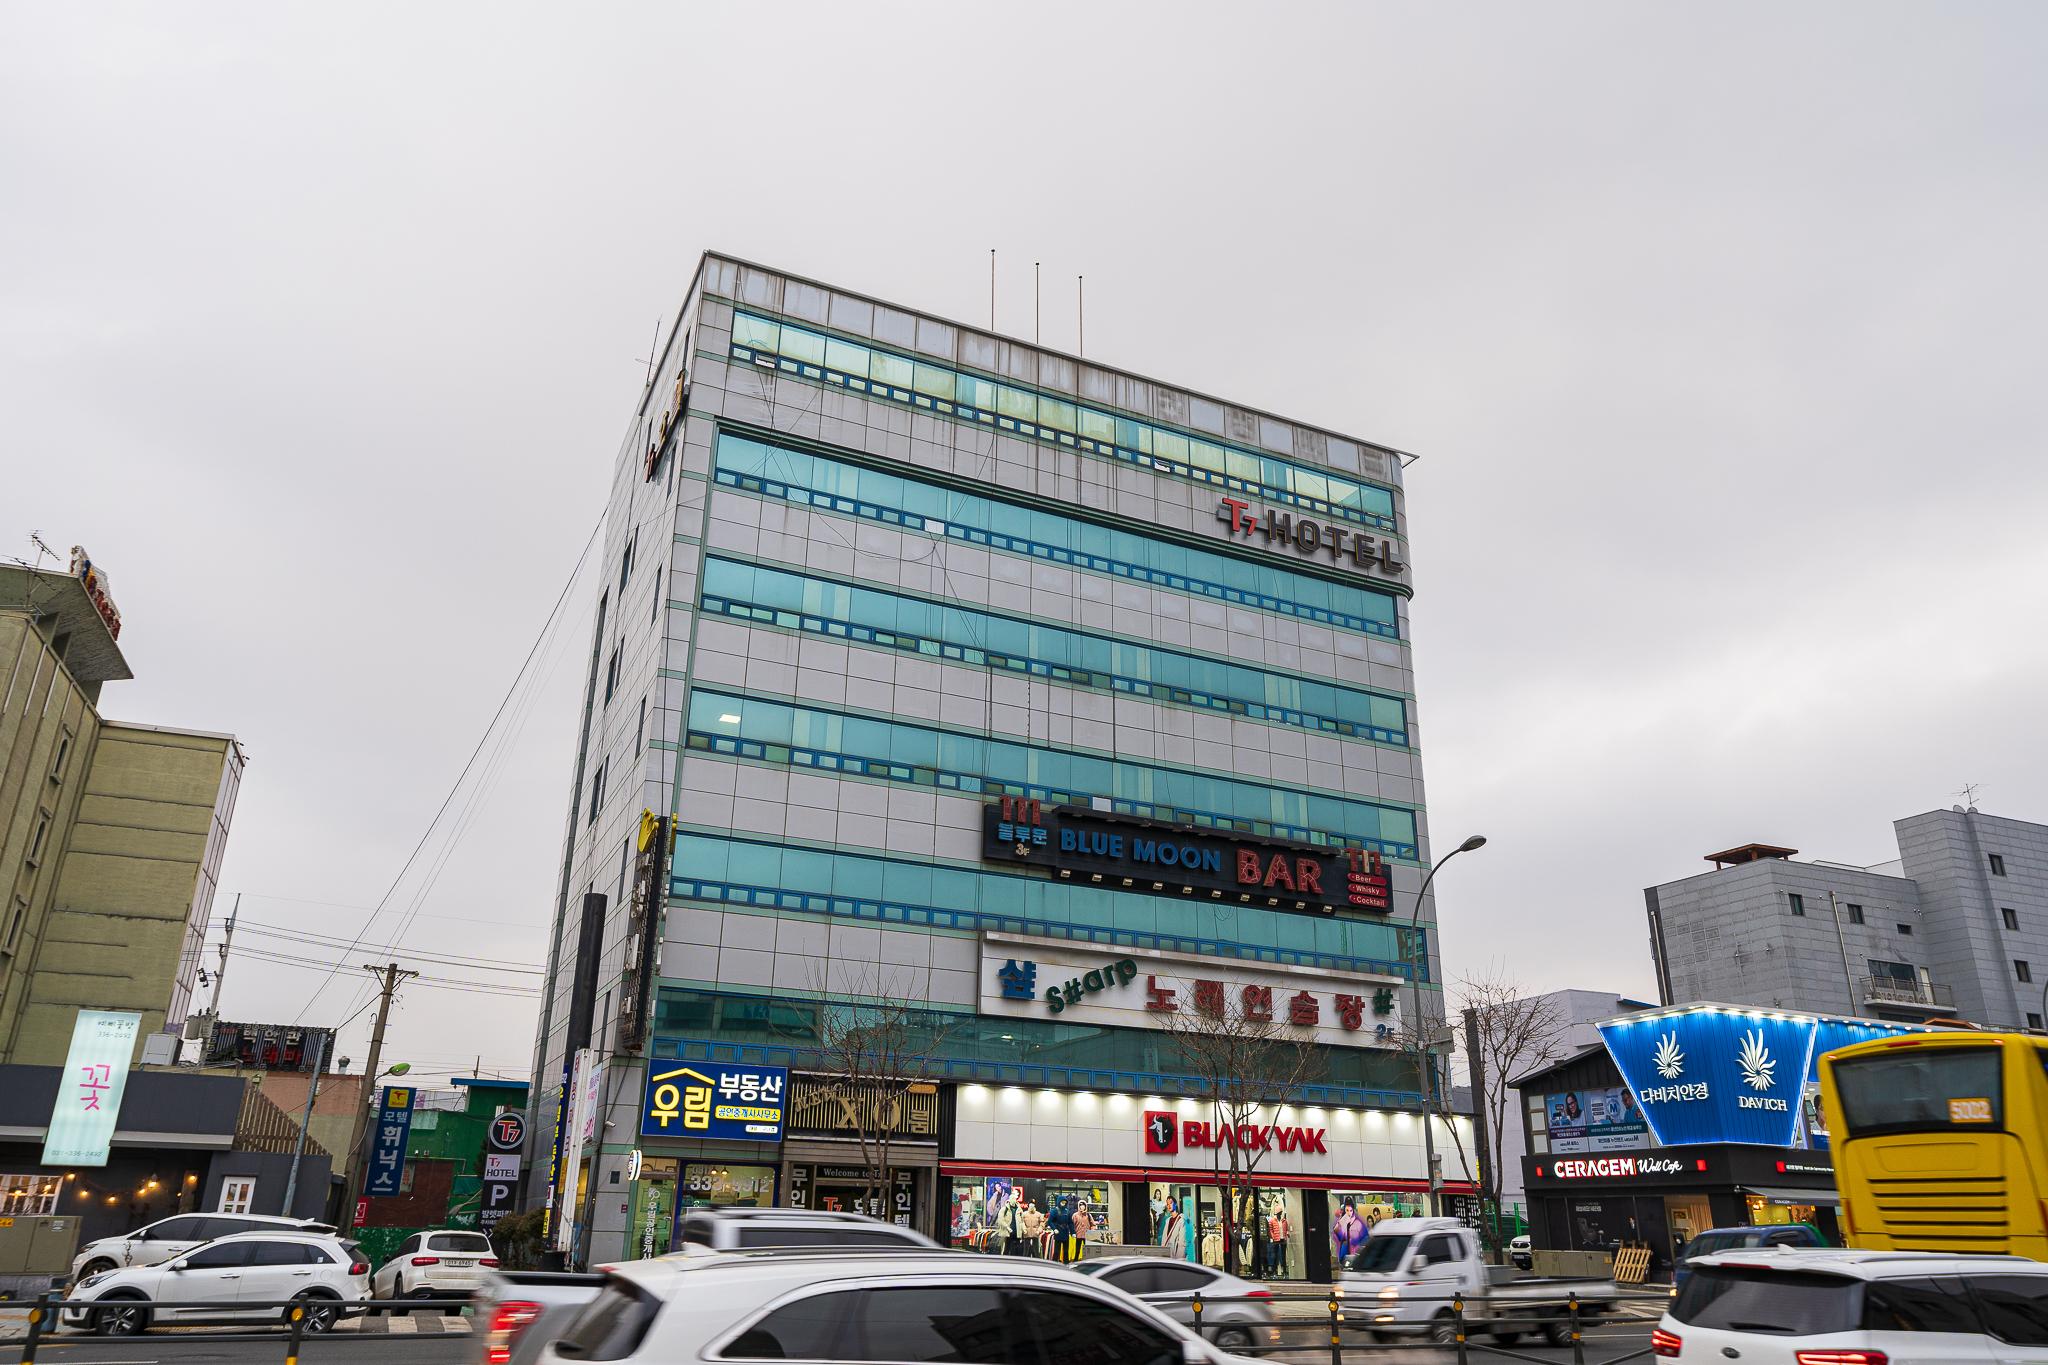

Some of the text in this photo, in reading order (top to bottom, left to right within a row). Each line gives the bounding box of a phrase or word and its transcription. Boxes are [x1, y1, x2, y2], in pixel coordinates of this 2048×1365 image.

[1222, 498, 1404, 574] T7 HOTEL
[998, 822, 1048, 846] 블루문
[1060, 827, 1325, 895] BLUE MOON BAR
[1355, 874, 1371, 883] Beer
[1355, 884, 1380, 895] Whisky
[1356, 896, 1385, 907] Cocktail
[1145, 975, 1365, 1031] 노래연습장
[79, 1064, 111, 1110] 꽃
[718, 1072, 783, 1103] 부동산
[1640, 1082, 1709, 1104] 다비치안경
[650, 1083, 713, 1130] 우림
[1738, 1096, 1788, 1111] DAVICH
[383, 1111, 408, 1124] 모텔
[909, 1109, 929, 1134] 룸
[498, 1120, 520, 1143] T7
[371, 1126, 403, 1192] 휘닉스
[488, 1158, 502, 1168] T7
[1554, 1158, 1636, 1178] CERAGEM
[1637, 1157, 1662, 1174] Well
[486, 1168, 517, 1178] HOTEL
[823, 1167, 859, 1178] Welcome
[490, 1184, 509, 1206] P
